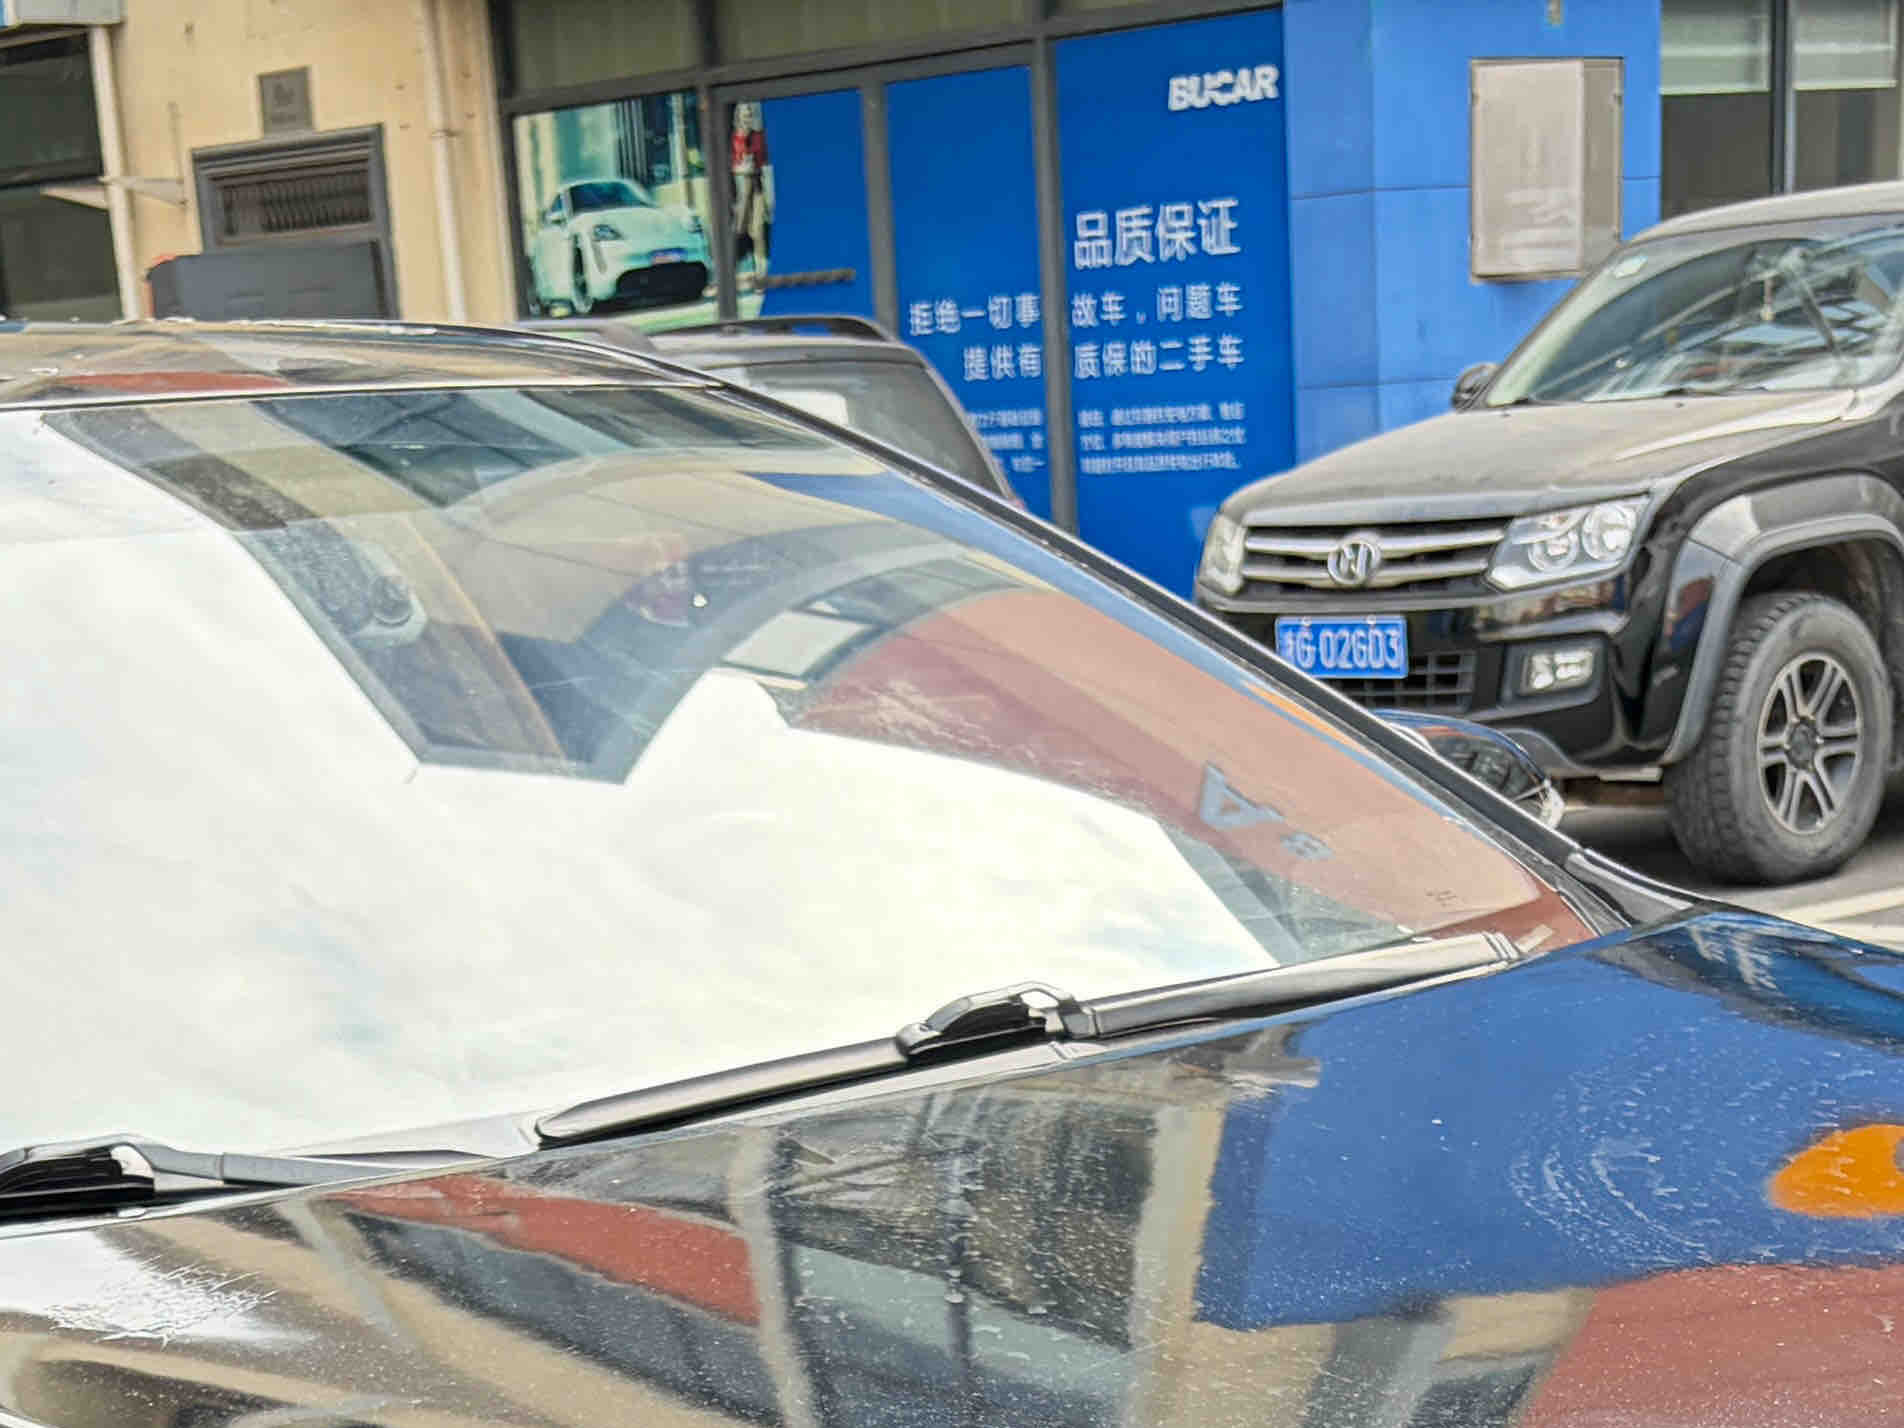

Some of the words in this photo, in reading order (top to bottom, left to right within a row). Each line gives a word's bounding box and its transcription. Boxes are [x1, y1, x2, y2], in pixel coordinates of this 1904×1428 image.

[1168, 64, 1280, 110] BUCAR
[1074, 198, 1242, 270] 品质保证
